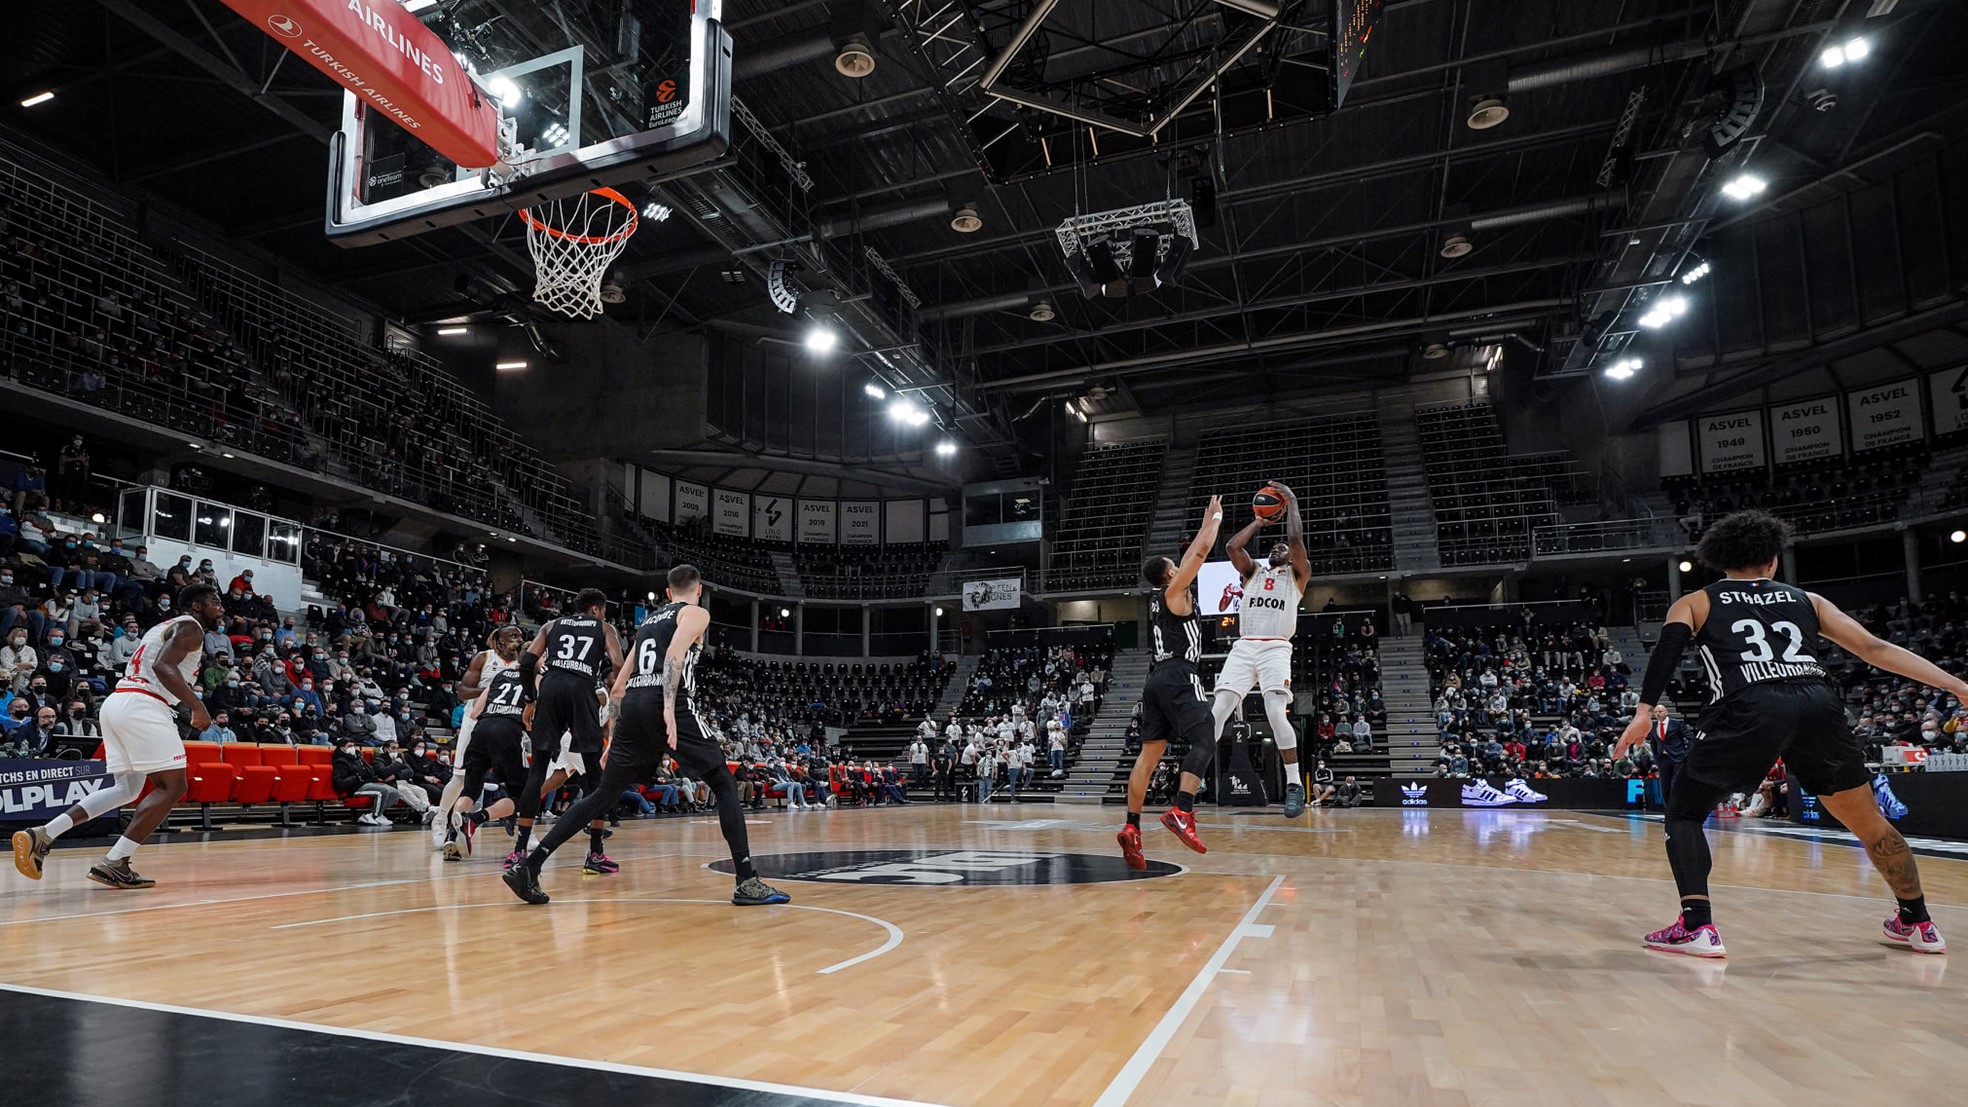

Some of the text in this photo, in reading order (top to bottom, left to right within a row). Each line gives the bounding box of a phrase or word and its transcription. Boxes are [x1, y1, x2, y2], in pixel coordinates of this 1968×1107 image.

[348, 0, 443, 85] AIRLINES
[303, 39, 421, 129] TURKISH AIRLINES
[650, 99, 682, 114] TURKISH
[650, 107, 682, 122] AIRLINES
[1861, 387, 1908, 406] ASVEL
[1781, 404, 1828, 421] ASVEL
[1870, 410, 1901, 423] 1952
[1708, 418, 1752, 432] ASVEL
[1790, 425, 1820, 438] 1950
[1863, 425, 1912, 441] CHAMPION
[1784, 441, 1830, 454] CHAMPION
[1711, 453, 1754, 464] CHAMPION
[679, 485, 704, 498] ASVEL
[719, 494, 744, 505] ASVEL
[803, 504, 831, 513] ASVEL
[846, 505, 874, 514] ASVEL
[1264, 577, 1275, 591] 8
[1719, 590, 1797, 606] STRAZEL
[1221, 616, 1235, 627] 24
[557, 634, 594, 661] 37
[1731, 618, 1818, 663] 32
[131, 644, 146, 675] 4
[638, 637, 657, 675] 6
[492, 682, 523, 706] 21
[25, 770, 39, 781] EN
[41, 766, 74, 780] DIRECT
[75, 764, 91, 776] SUR
[0, 778, 104, 814] LPLAY
[1401, 798, 1428, 806] adidas
